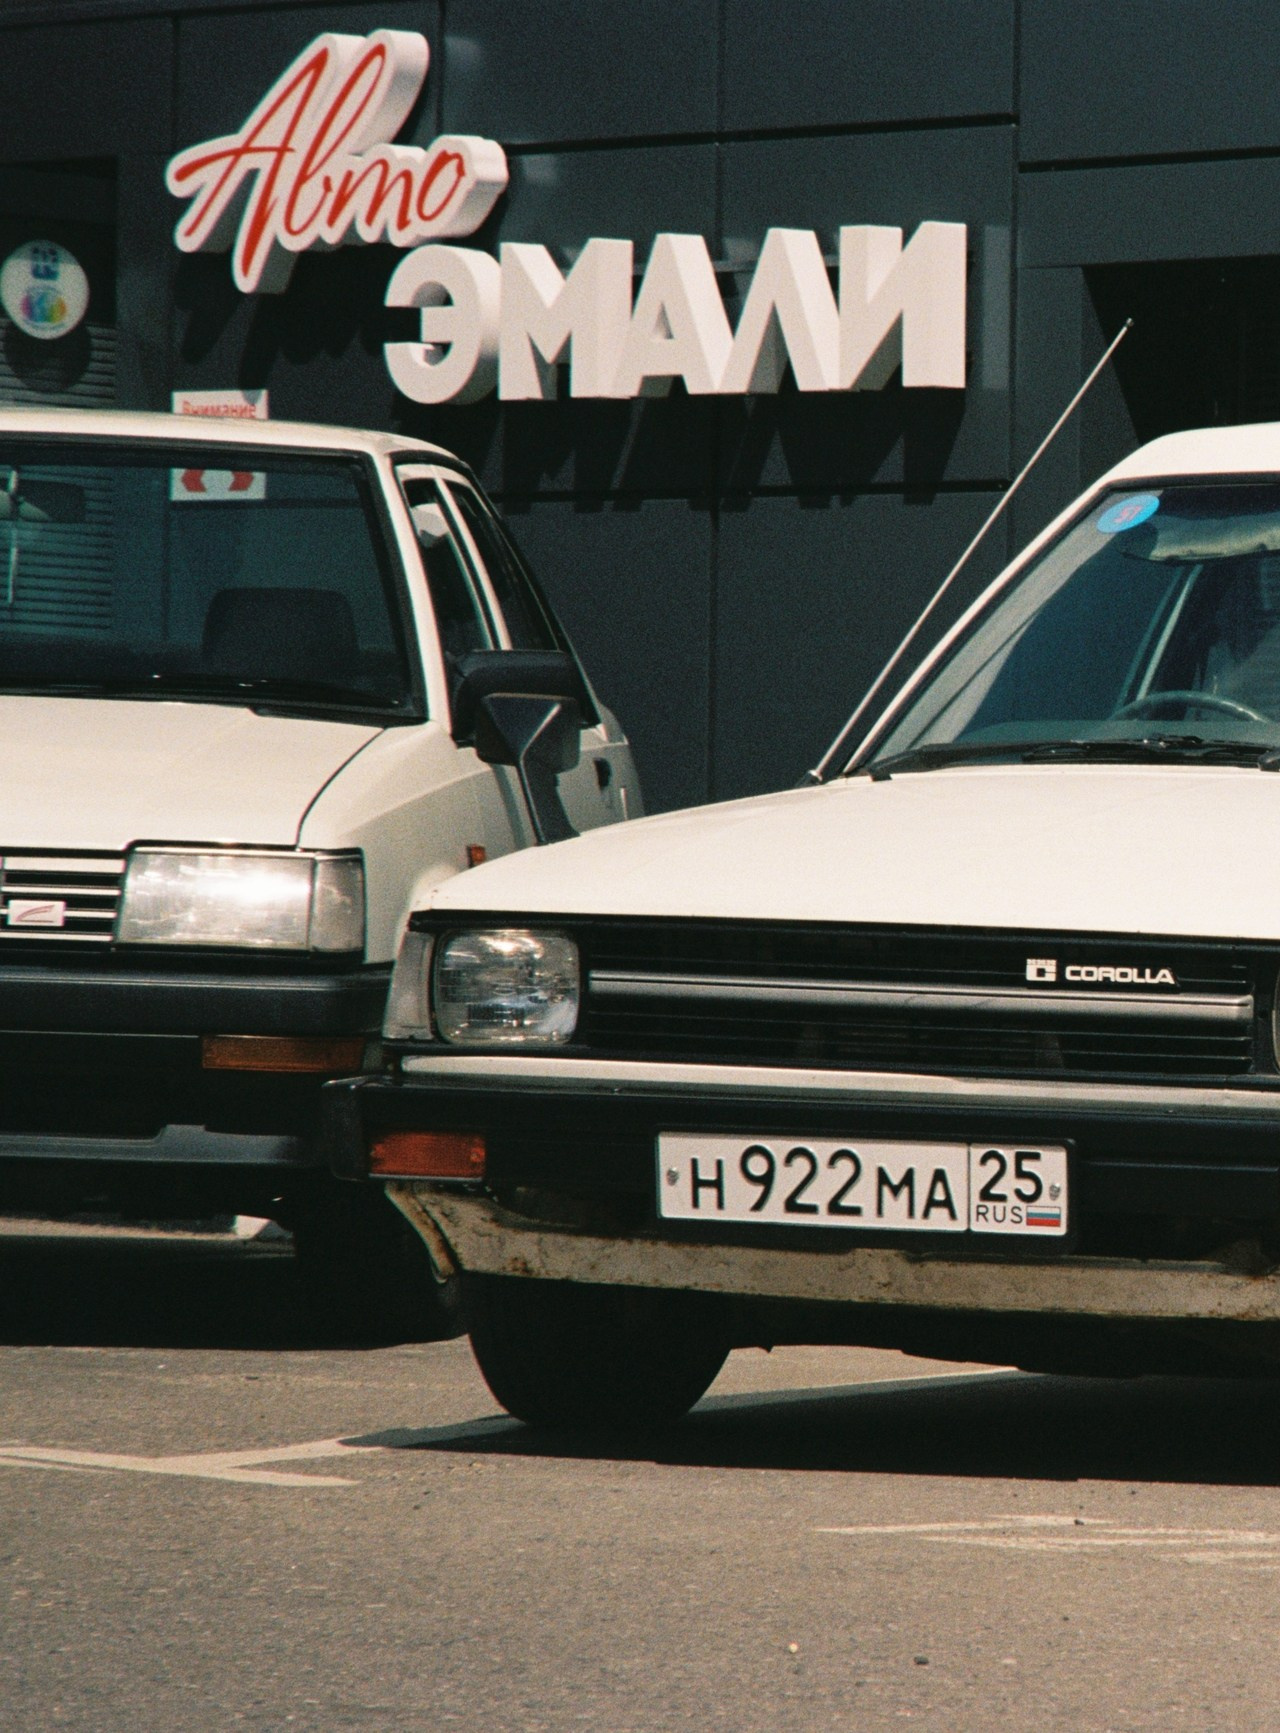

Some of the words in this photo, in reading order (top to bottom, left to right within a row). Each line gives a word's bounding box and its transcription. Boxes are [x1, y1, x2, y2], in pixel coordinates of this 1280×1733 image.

[384, 220, 967, 404] ЭМАЛИ
[1065, 965, 1176, 985] COROLLA
[979, 1149, 1043, 1204] 25
[976, 1204, 1024, 1225] RUS
